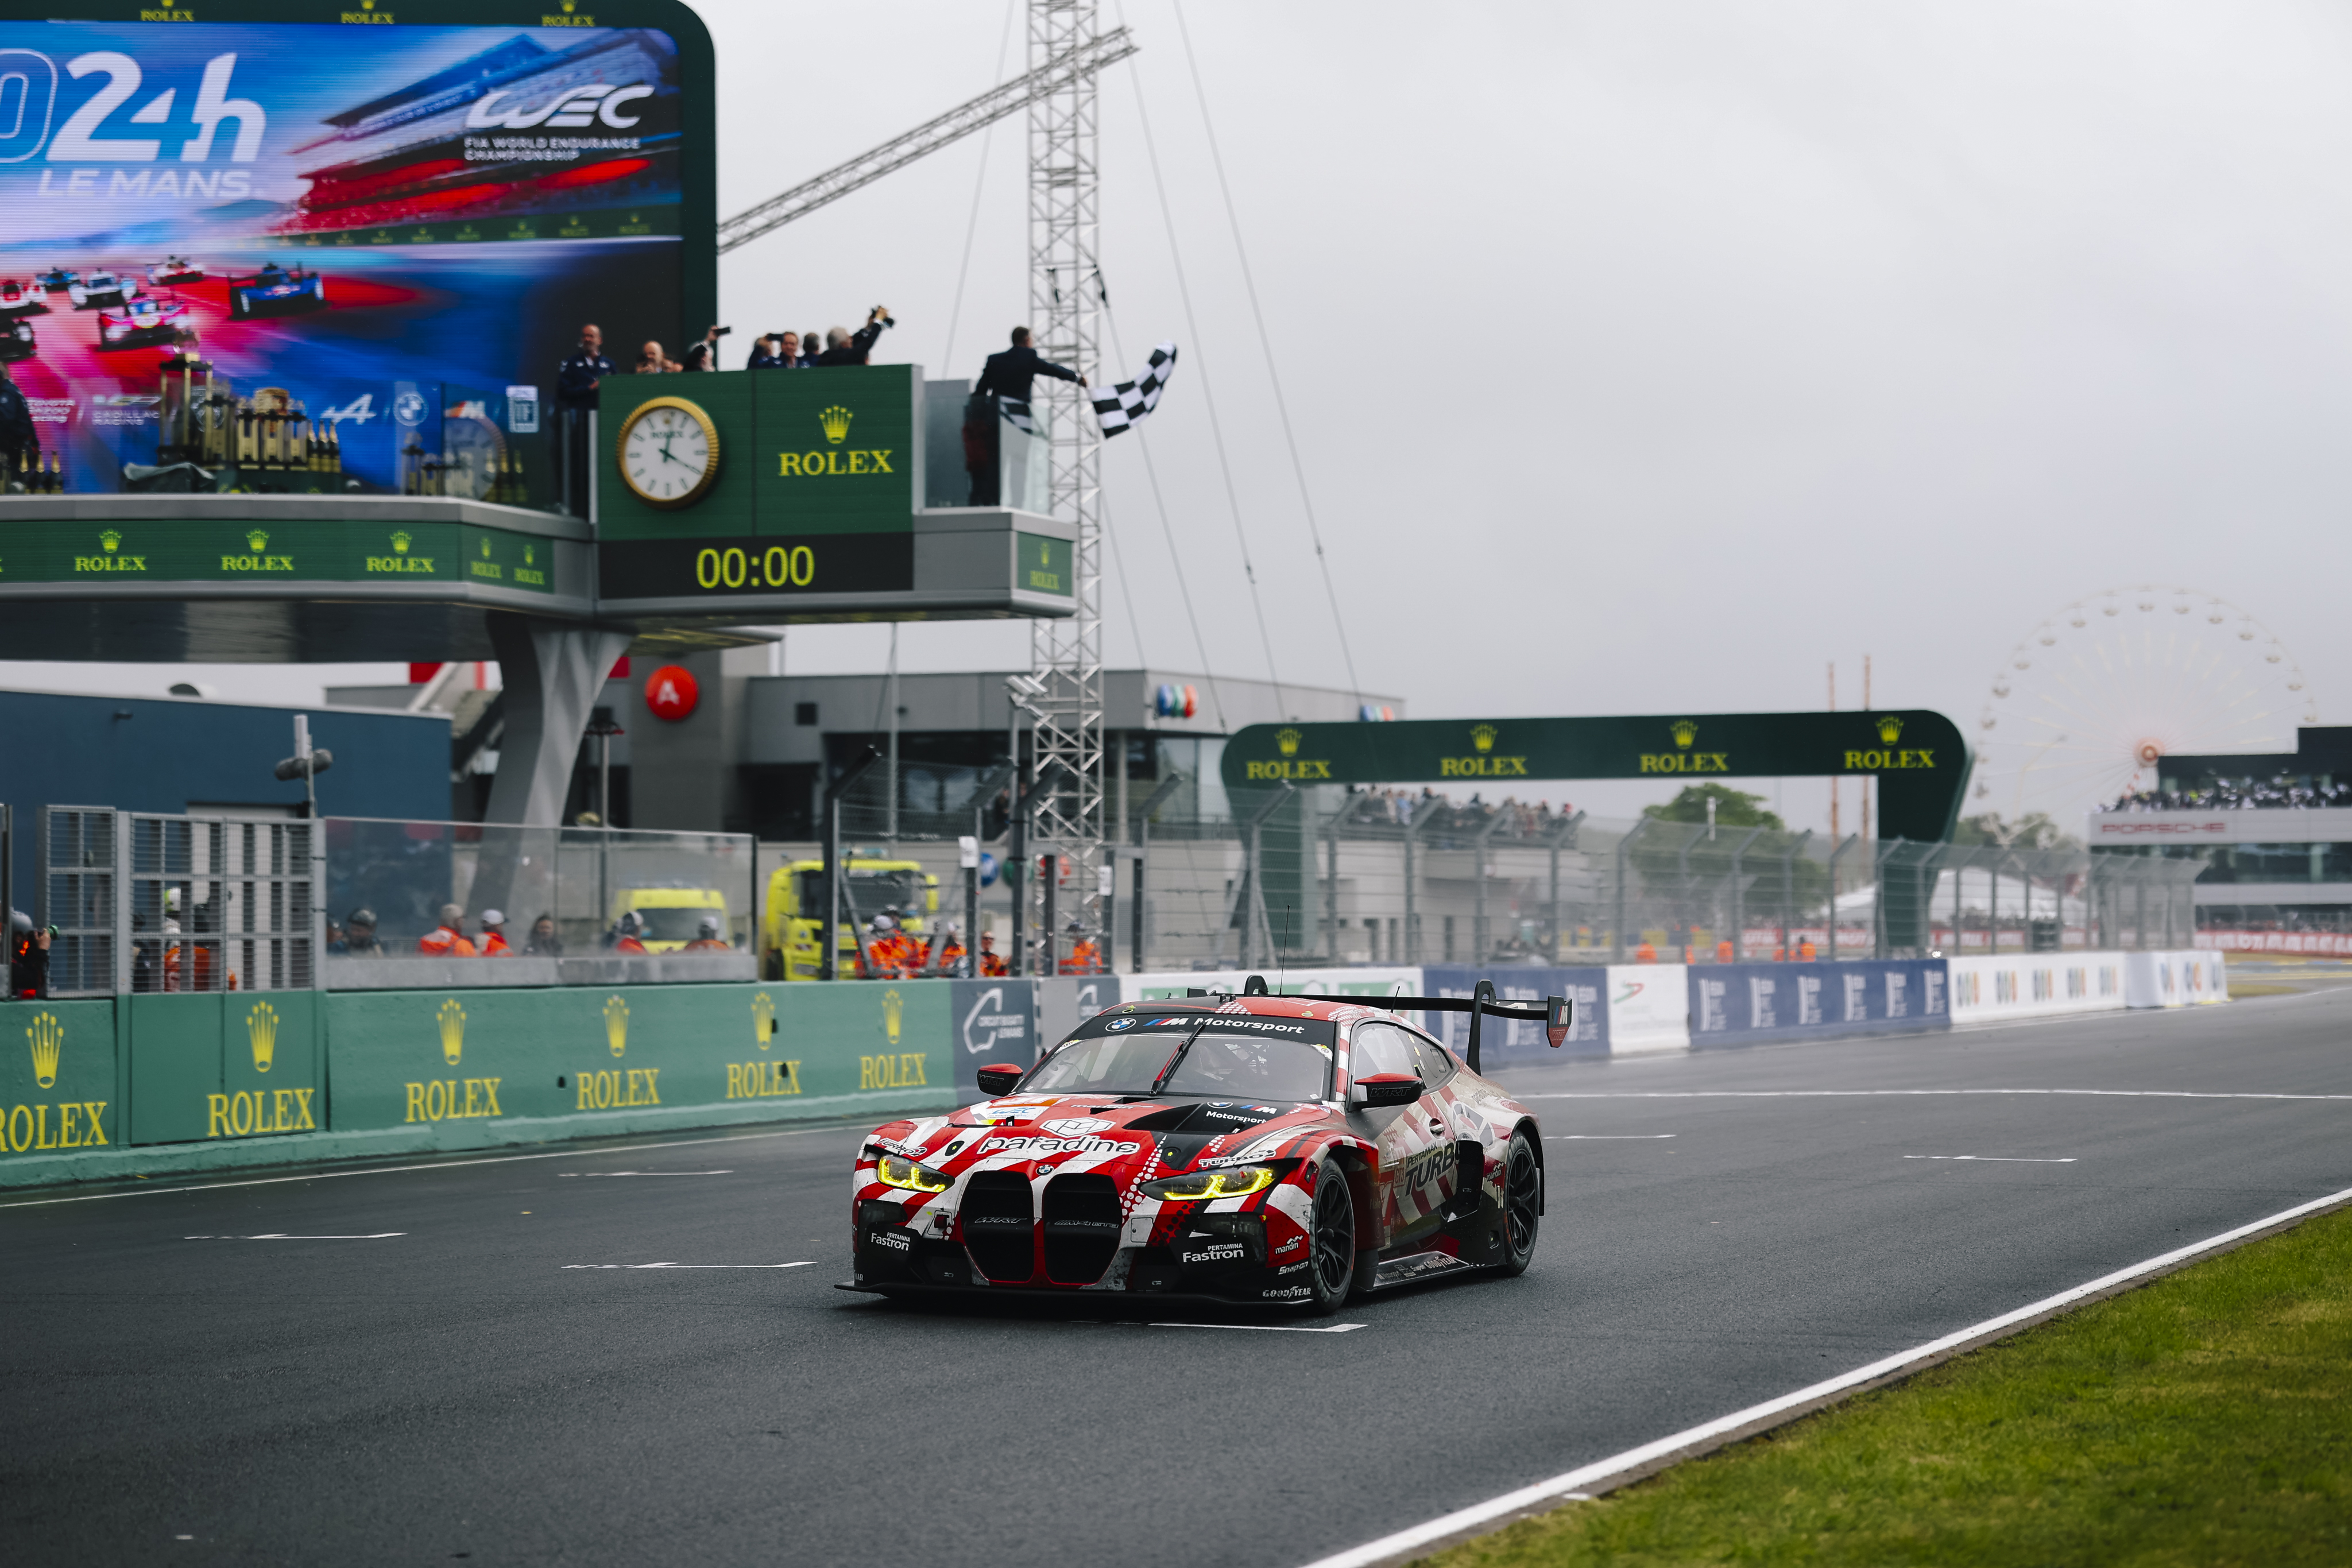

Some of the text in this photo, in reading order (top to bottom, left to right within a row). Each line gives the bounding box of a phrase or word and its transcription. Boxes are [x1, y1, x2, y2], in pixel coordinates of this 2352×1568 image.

[141, 10, 194, 21] ROLEX
[341, 12, 394, 24] ROLEX
[542, 15, 595, 26] ROLEX
[465, 84, 655, 129] WEC
[464, 136, 641, 149] FIA WORLD ENDURANCE
[464, 148, 581, 161] CHAMPIONSHIP
[37, 169, 253, 198] LE MANS
[92, 411, 160, 419] CADILLAC
[779, 449, 893, 477] ROLEX
[75, 556, 147, 571] ROLEX
[222, 555, 294, 571] ROLEX
[366, 556, 435, 573] ROLEX
[697, 546, 814, 589] 00:00
[657, 679, 680, 706] A
[1441, 756, 1527, 776] ROLEX
[1640, 753, 1729, 773] ROLEX
[1844, 749, 1935, 769] ROLEX
[1247, 760, 1331, 780] ROLEX
[2101, 822, 2226, 834] PORSCHE
[1193, 1017, 1305, 1034] Motorsport
[726, 1059, 803, 1099] ROLEX
[859, 1052, 928, 1090] ROLEX
[575, 1067, 662, 1110] ROLEX
[978, 1074, 1004, 1086] WRT
[404, 1077, 503, 1123] ROLEX
[1370, 1087, 1411, 1097] WRT
[207, 1087, 316, 1137] ROLEX
[1206, 1111, 1267, 1124] Motorsport
[980, 1136, 1138, 1153] paradine
[1407, 1142, 1438, 1168] PERTAMAX
[1395, 1167, 1405, 1184] GT3
[871, 1232, 910, 1251] Fastron
[887, 1232, 910, 1242] PERTAMINA
[1208, 1243, 1243, 1251] PERTAMINA
[1182, 1249, 1244, 1263] Fastron
[1278, 1261, 1309, 1275] Snap-on
[1262, 1286, 1312, 1299] GOODYEAR
